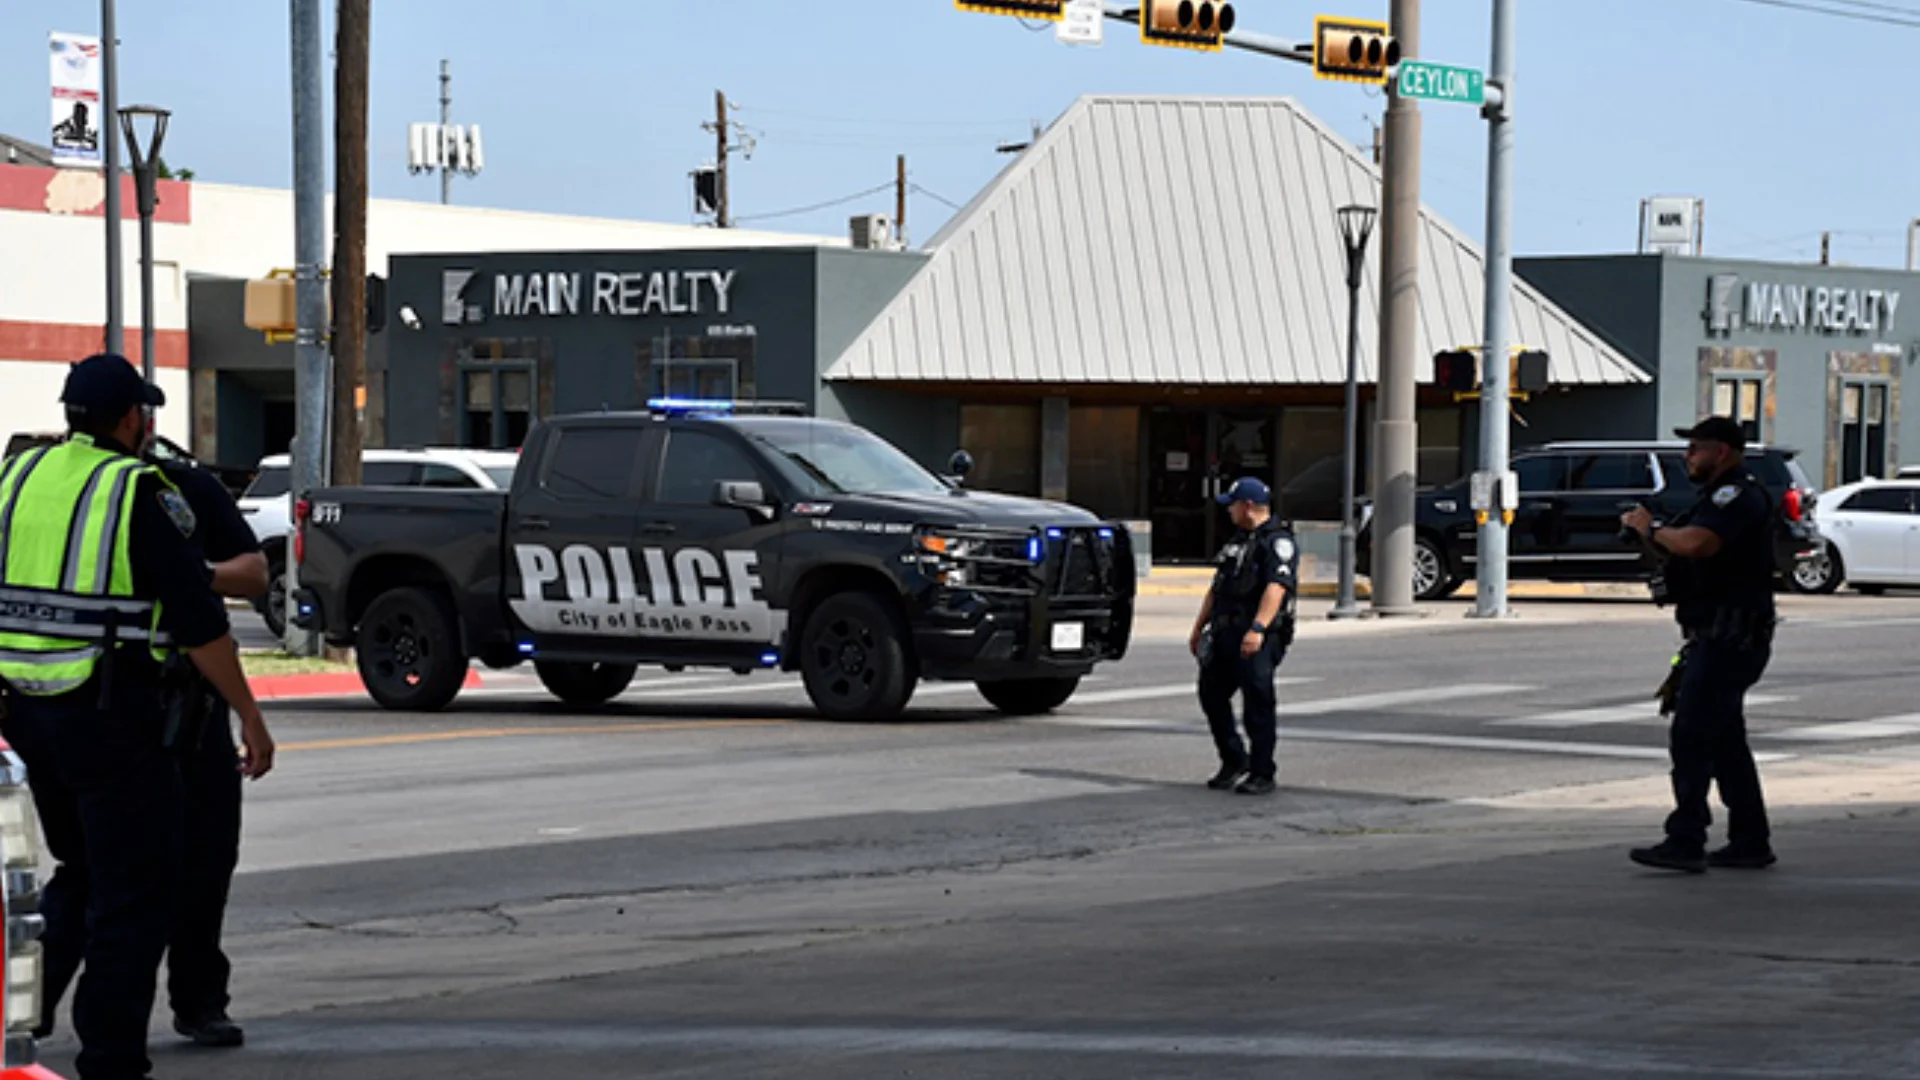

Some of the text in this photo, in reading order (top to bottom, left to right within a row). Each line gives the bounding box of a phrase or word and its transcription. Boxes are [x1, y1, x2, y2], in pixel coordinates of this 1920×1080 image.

[1402, 65, 1469, 99] CEYLON
[494, 269, 734, 315] MAIN REALTY
[1750, 281, 1900, 331] MAIN REALTY
[513, 543, 763, 607] POLICE
[558, 608, 753, 633] City of Eagle Pass
